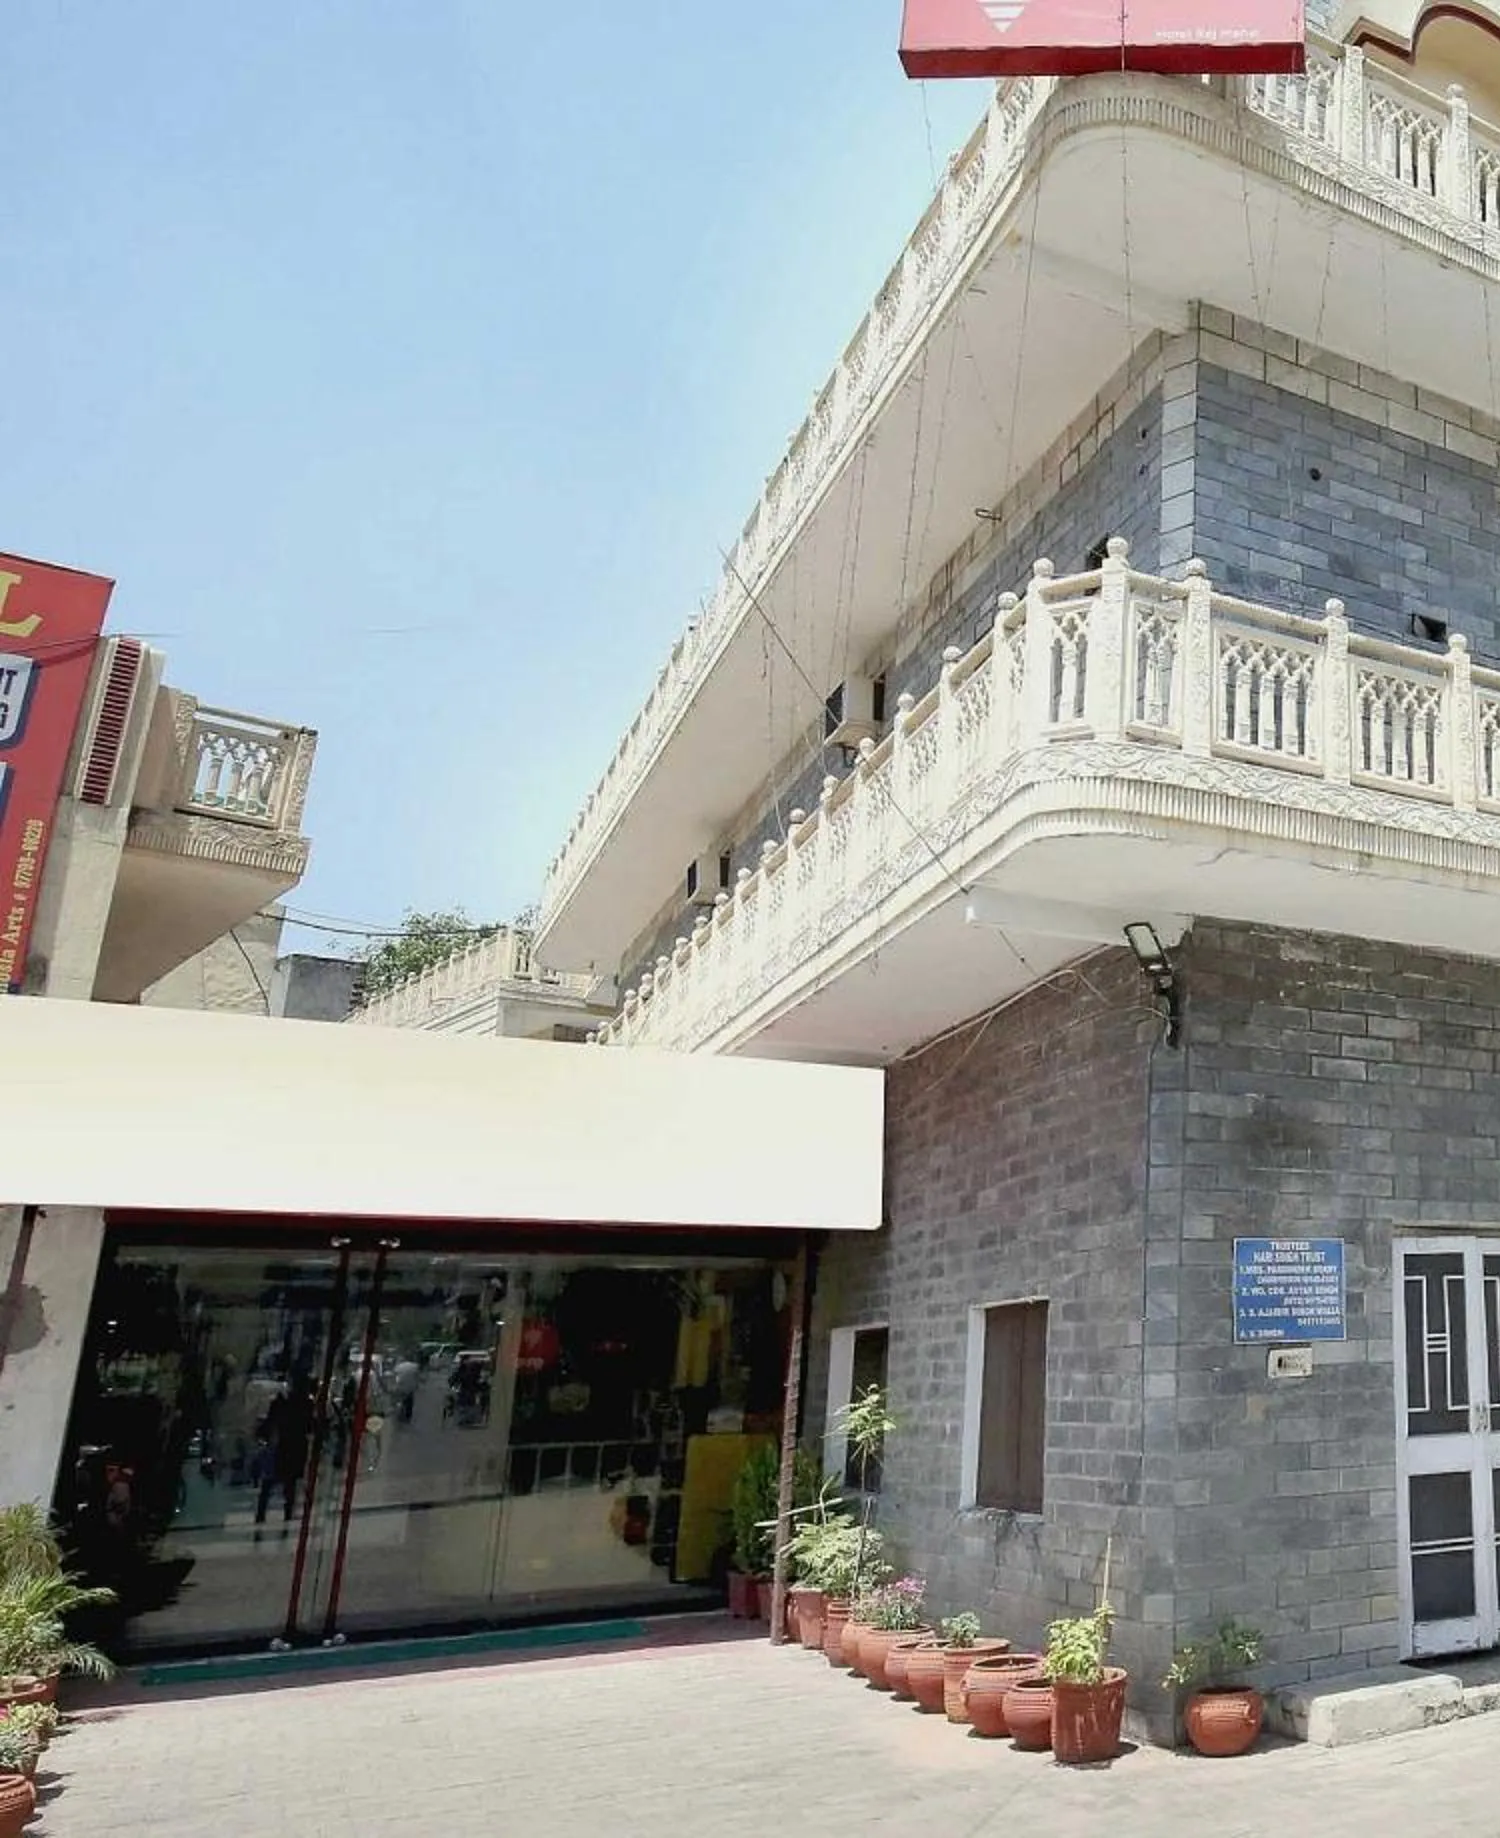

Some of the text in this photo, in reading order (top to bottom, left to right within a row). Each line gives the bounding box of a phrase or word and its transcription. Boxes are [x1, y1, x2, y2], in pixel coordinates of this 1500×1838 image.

[1269, 1241, 1310, 1251] TRUSTEES
[1253, 1251, 1326, 1263] HARI SINGH TRUST
